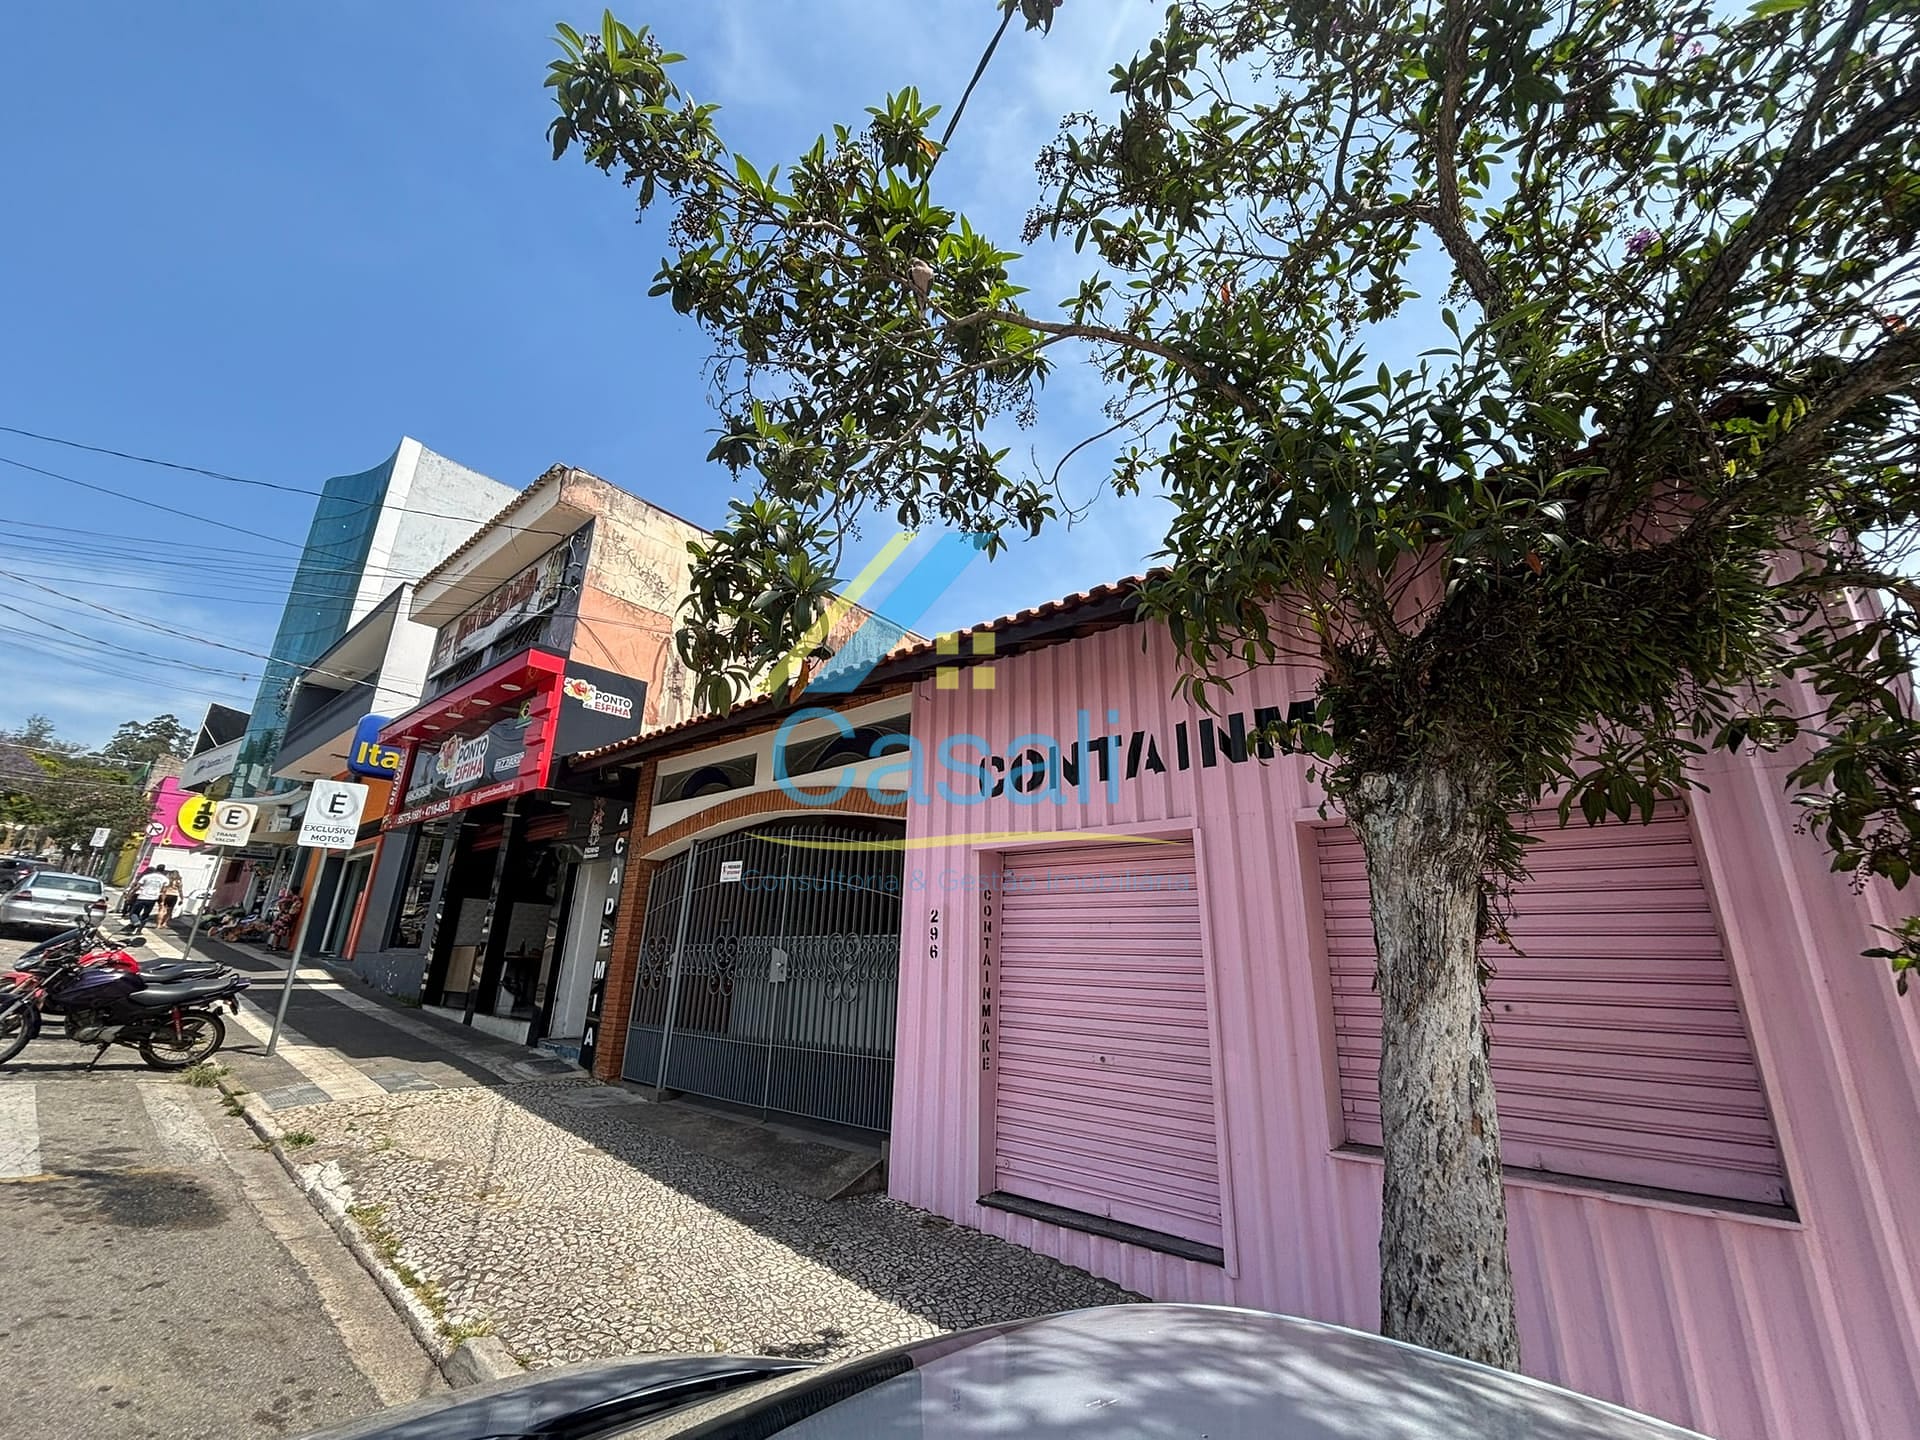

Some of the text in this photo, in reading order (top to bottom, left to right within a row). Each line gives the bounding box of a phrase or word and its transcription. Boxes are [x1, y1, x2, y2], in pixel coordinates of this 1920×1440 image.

[594, 701, 629, 717] ESFIHA
[595, 692, 631, 708] PONTO
[457, 738, 488, 764] PONTO
[454, 759, 482, 783] ESFIHA
[328, 793, 348, 814] E
[225, 809, 242, 825] E
[304, 824, 356, 836] EXCLUSIVO
[310, 834, 345, 844] MOTOS
[583, 807, 629, 1046] ACADEMIA
[928, 908, 940, 960] 296
[981, 889, 993, 1072] CONTAINMAKE
